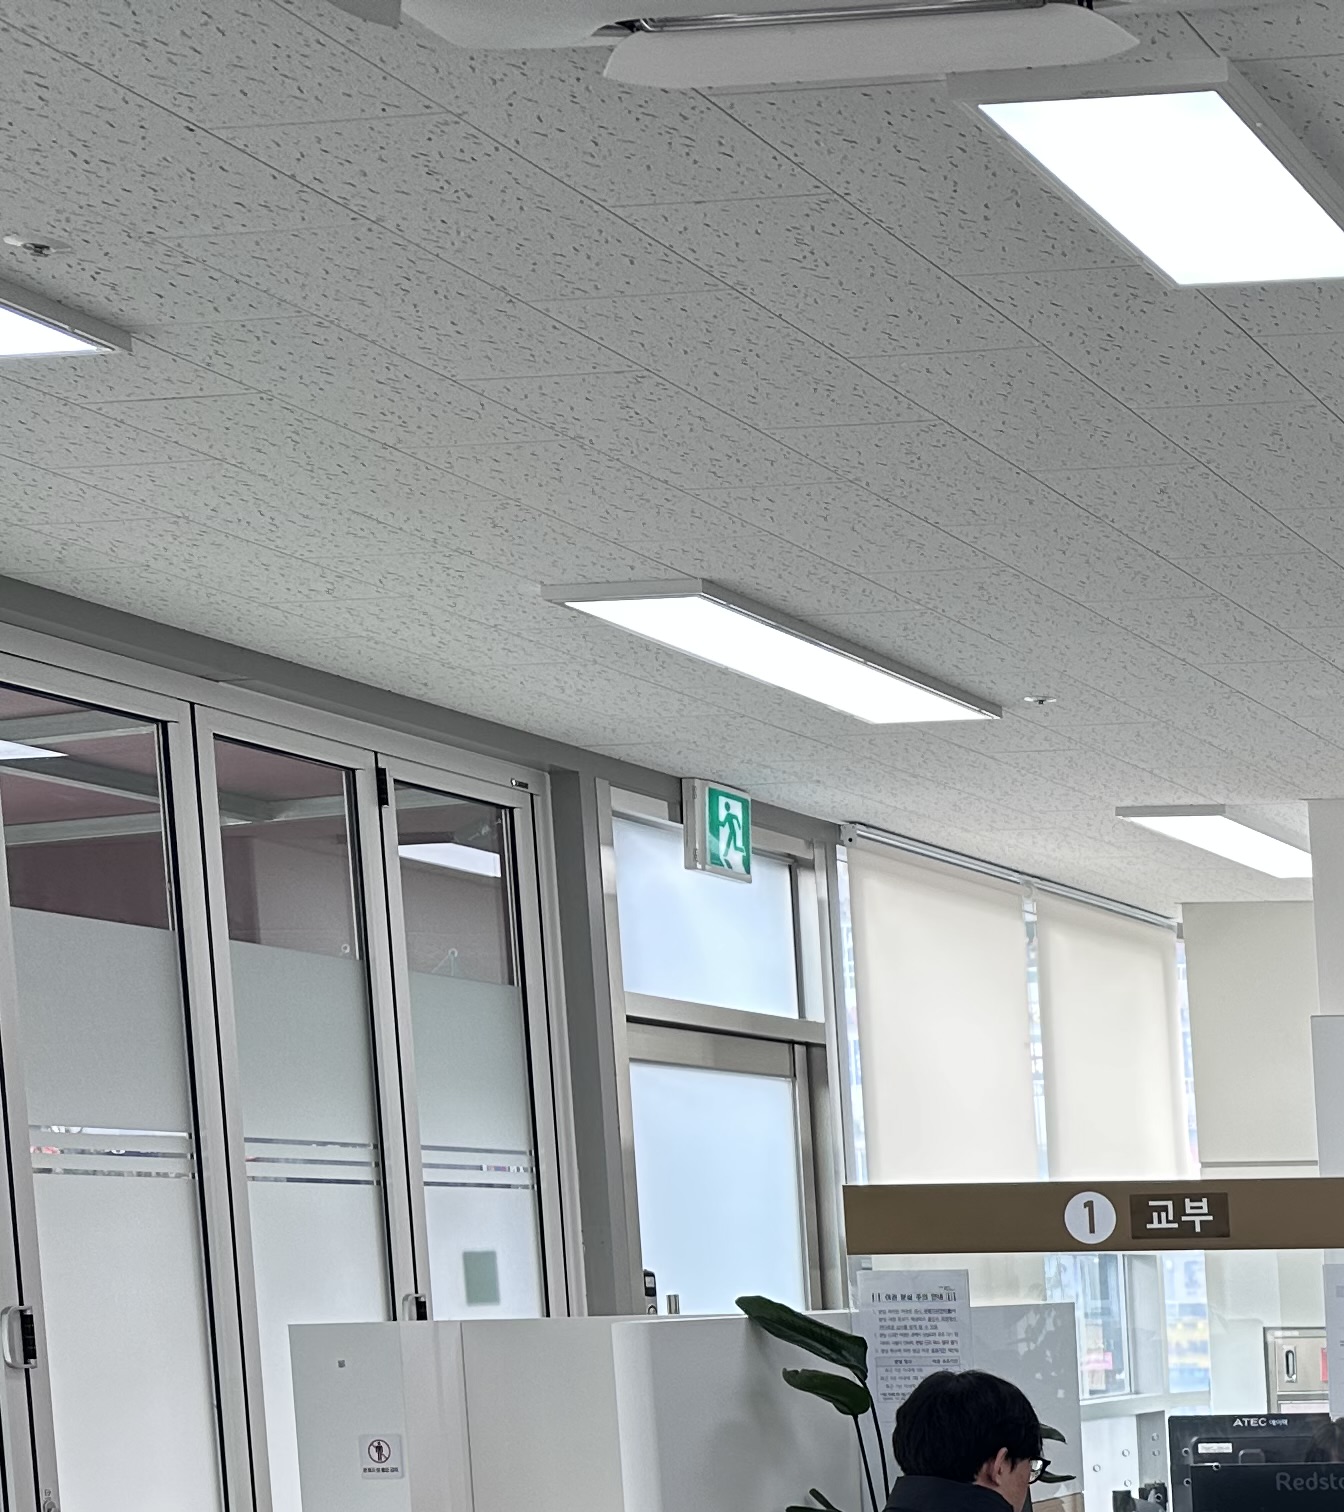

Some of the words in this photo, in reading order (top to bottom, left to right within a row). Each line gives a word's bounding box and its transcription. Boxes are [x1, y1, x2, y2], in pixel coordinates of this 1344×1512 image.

[1084, 1200, 1095, 1234] 1
[1147, 1198, 1213, 1232] 교부
[1233, 1418, 1266, 1426] ATEC
